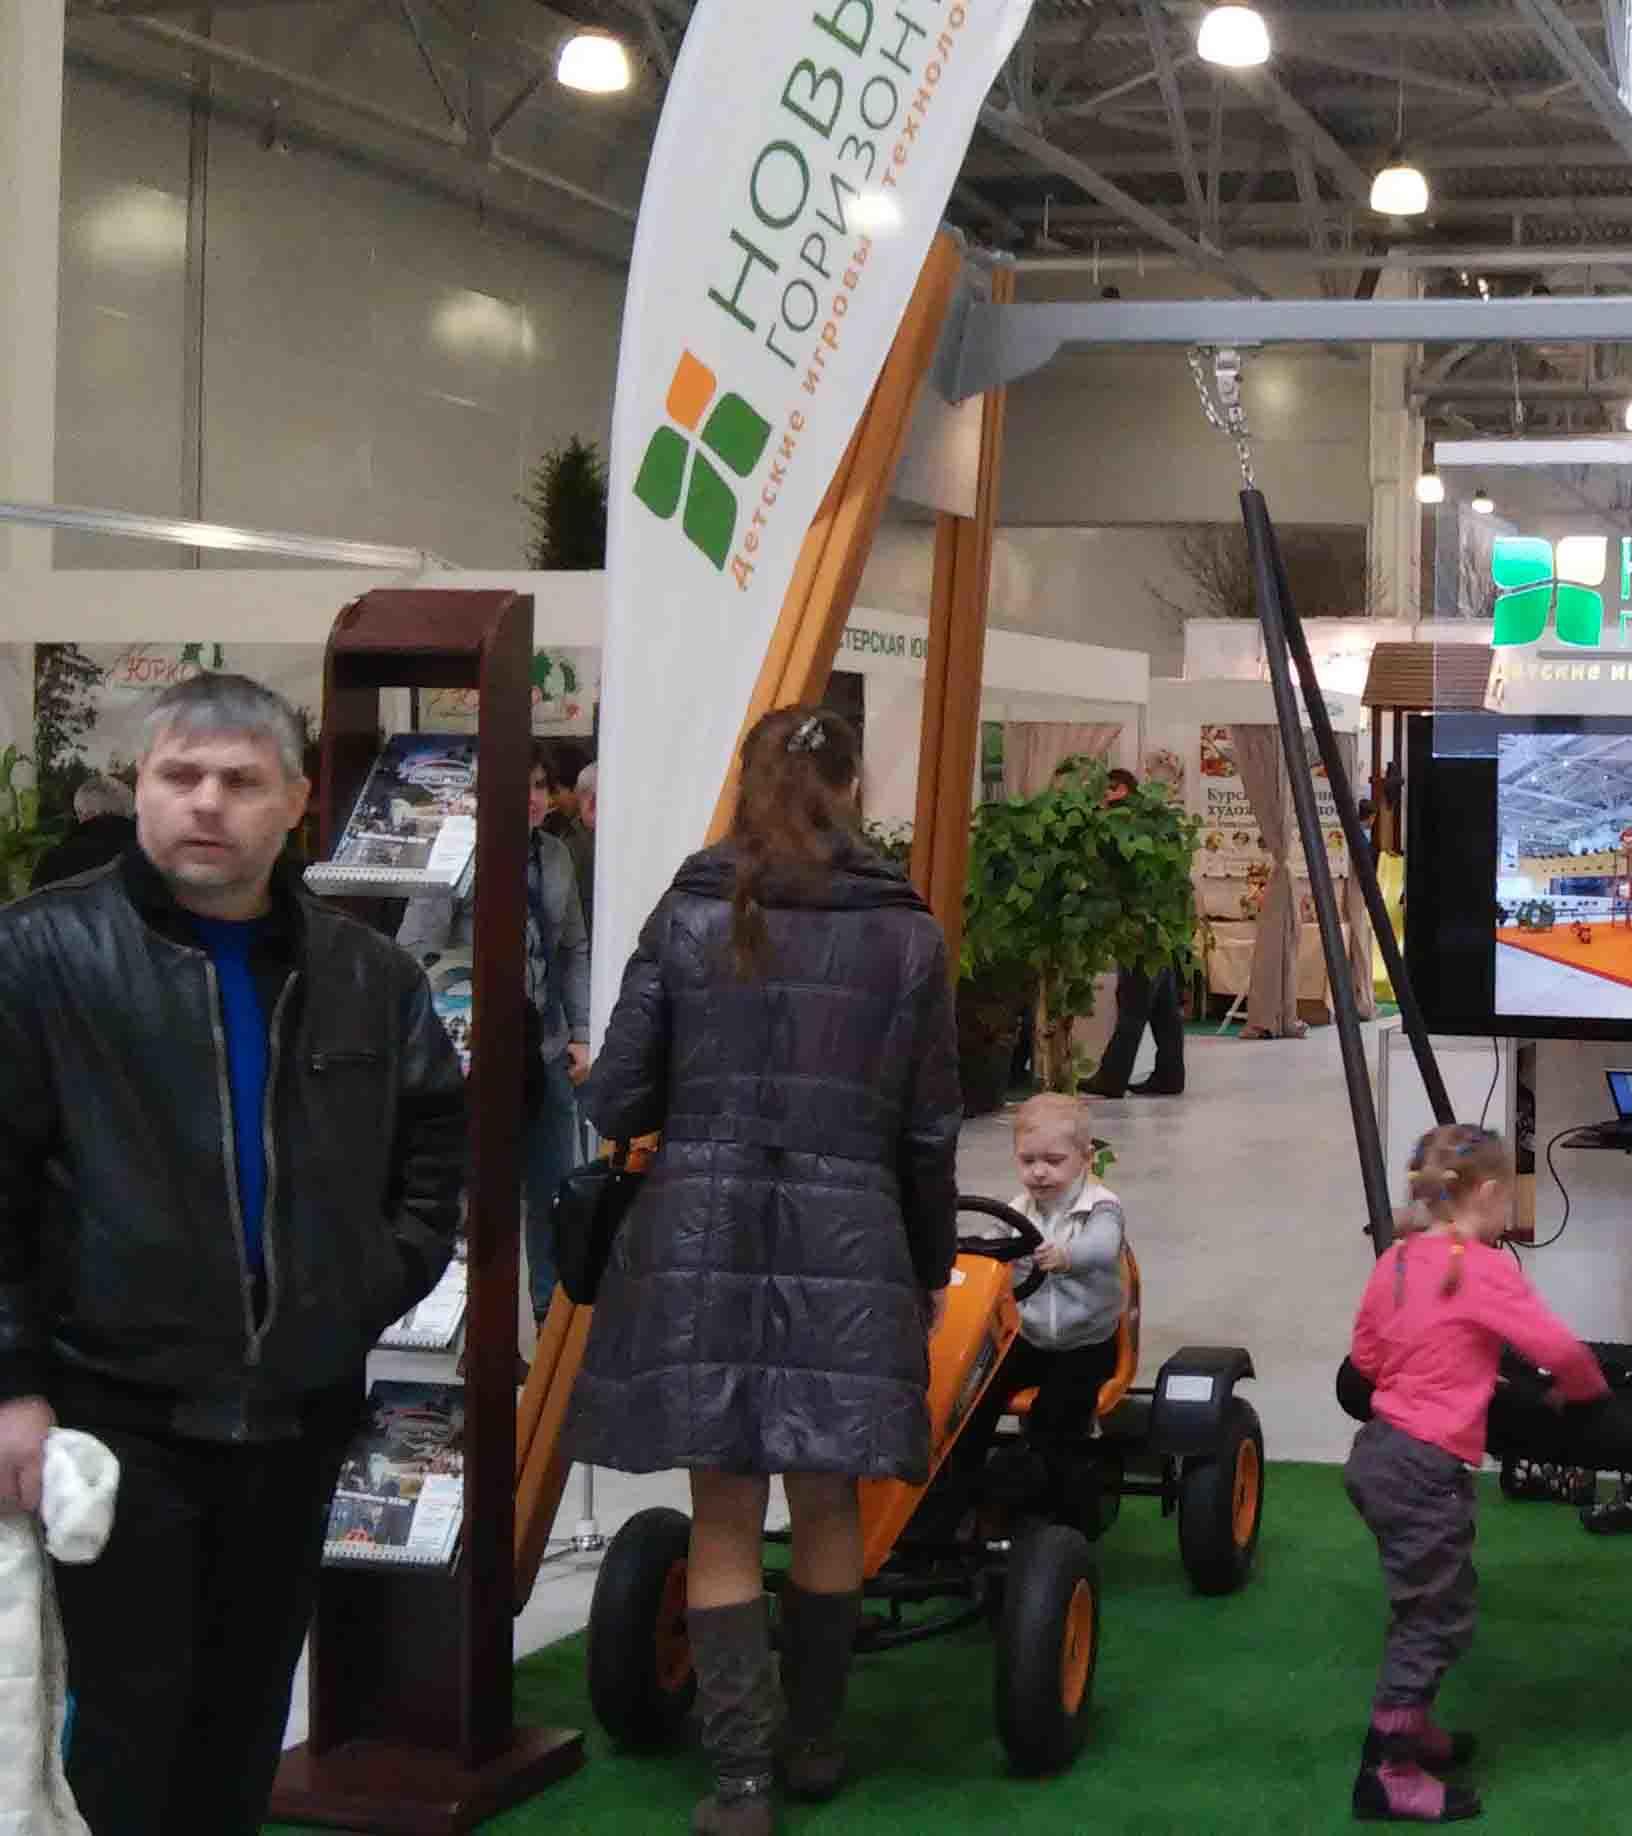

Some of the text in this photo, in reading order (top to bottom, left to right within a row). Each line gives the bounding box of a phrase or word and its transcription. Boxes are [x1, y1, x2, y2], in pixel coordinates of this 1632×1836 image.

[730, 0, 970, 593] Детские игровы техноло
[765, 0, 940, 368] ГОРИЗОН
[838, 625, 906, 657] ТЕРСКАЯ
